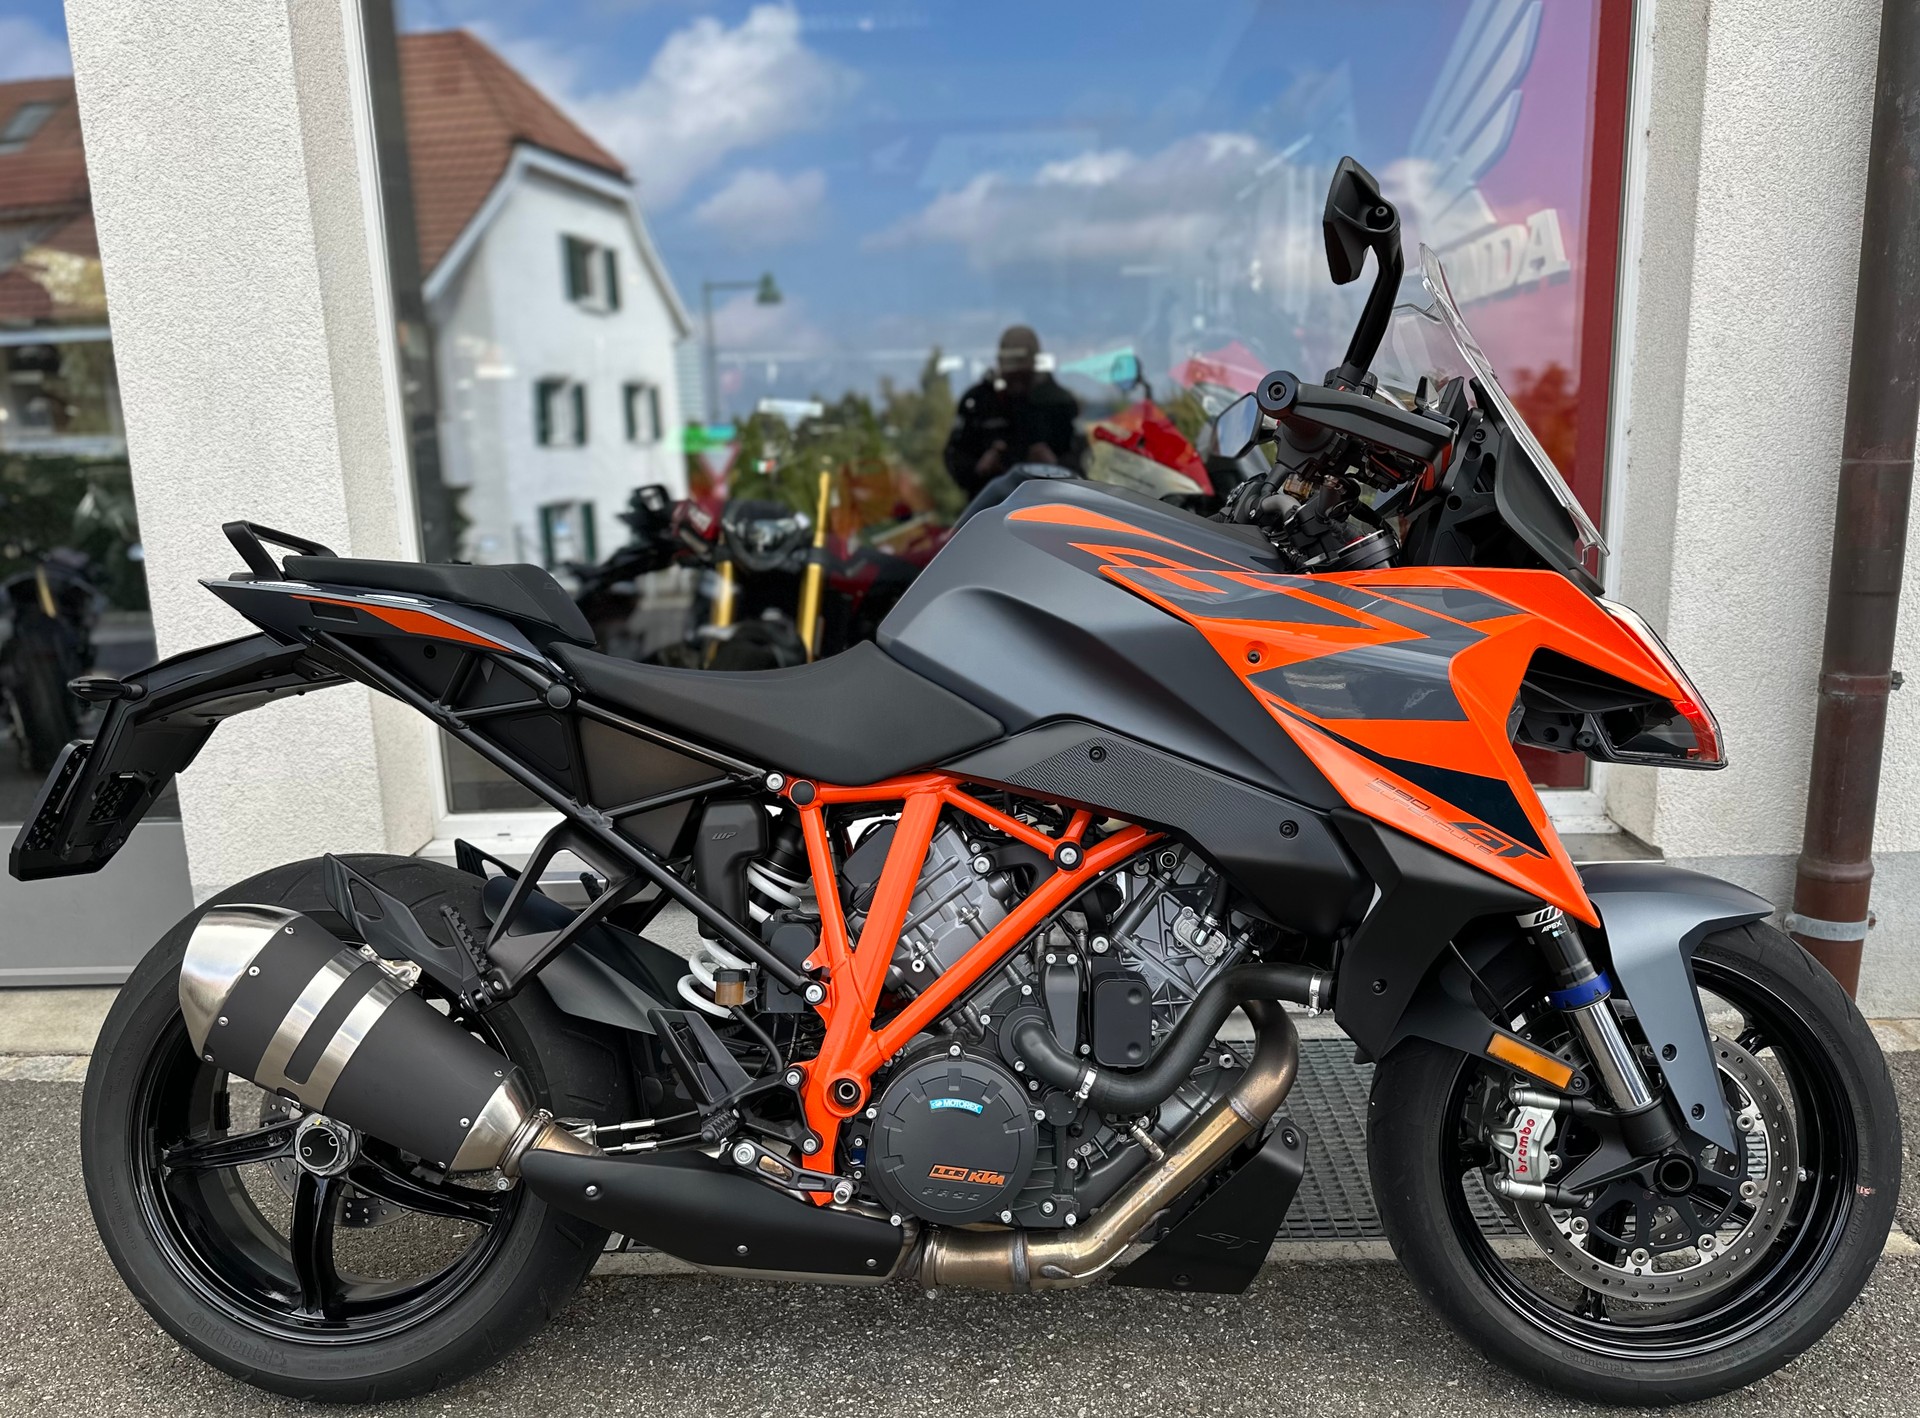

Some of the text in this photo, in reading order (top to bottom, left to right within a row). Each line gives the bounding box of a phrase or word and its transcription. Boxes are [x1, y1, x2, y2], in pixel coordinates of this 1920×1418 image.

[1374, 777, 1432, 811] 1290
[1449, 821, 1546, 860] GT
[1541, 919, 1563, 933] APEX
[943, 1098, 979, 1113] MOTOREX
[1515, 1118, 1536, 1174] brembo
[967, 1169, 1005, 1186] KTM
